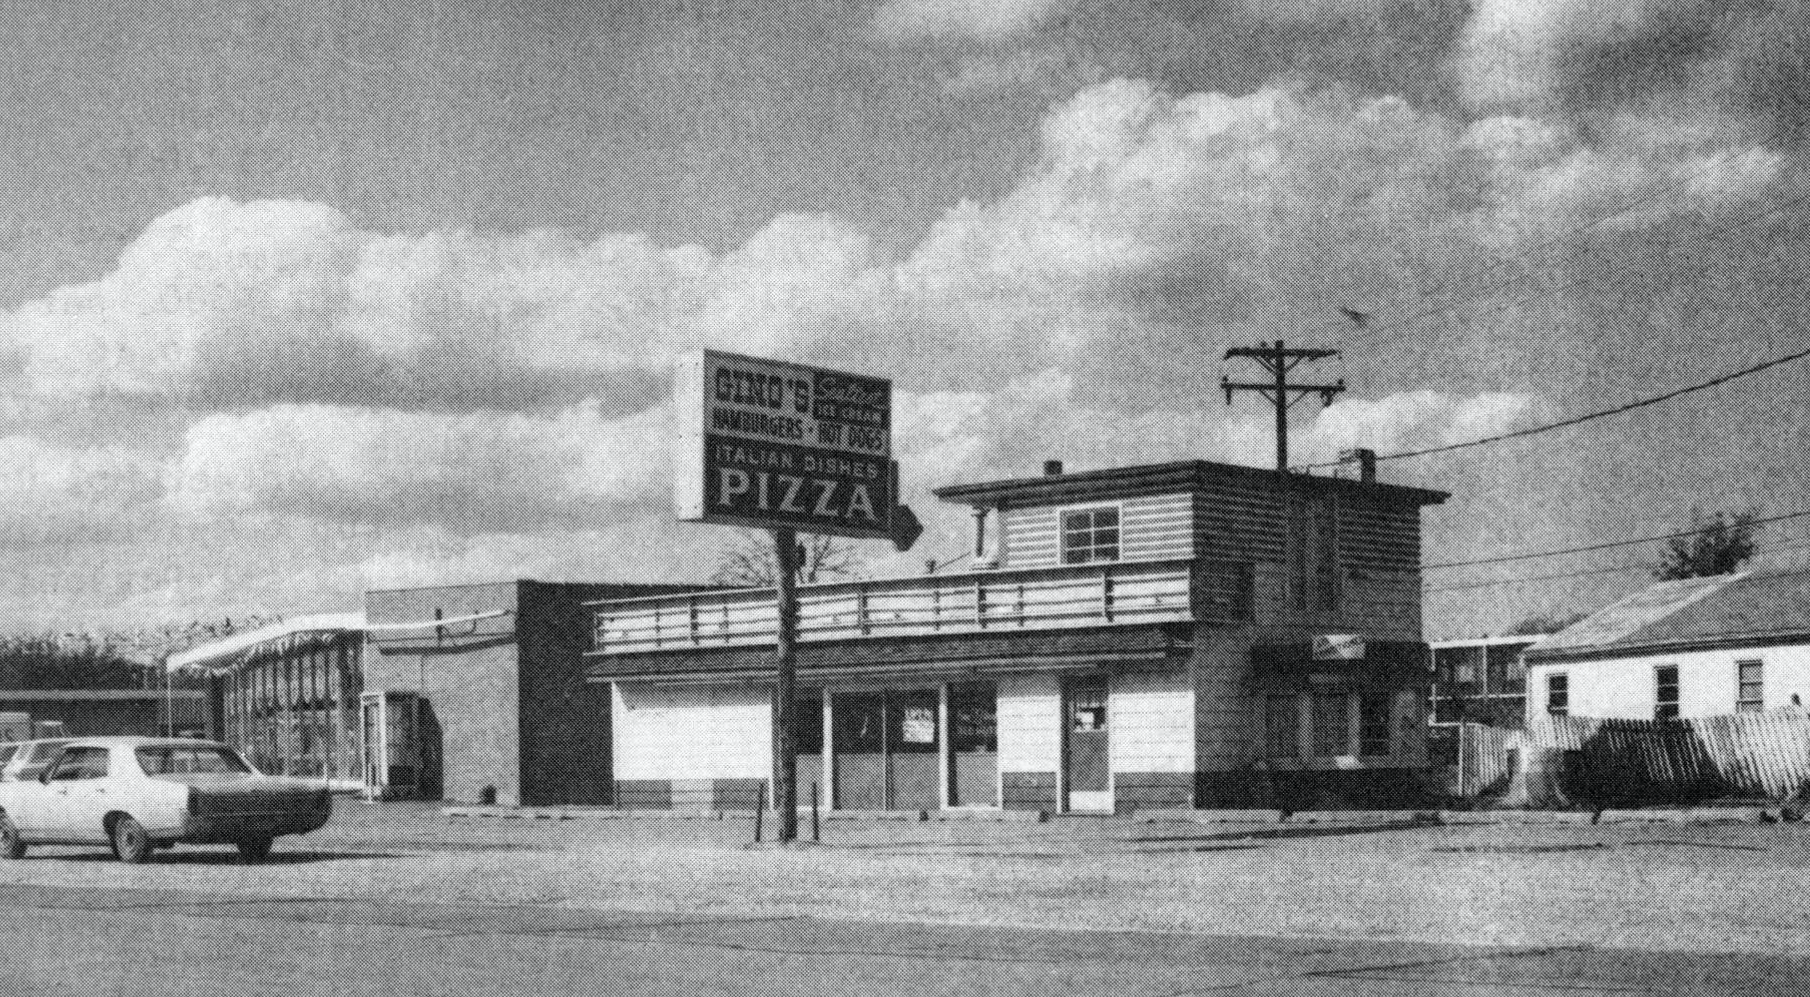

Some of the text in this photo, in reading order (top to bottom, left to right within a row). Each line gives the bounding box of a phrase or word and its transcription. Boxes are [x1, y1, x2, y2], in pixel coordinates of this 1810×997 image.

[716, 367, 810, 413] GINO'S
[817, 403, 836, 417] ICE
[713, 408, 883, 450] HAMBURGERS HOT DOGS
[716, 444, 878, 479] ITALIAN DISHES
[717, 467, 878, 521] PIZZA
